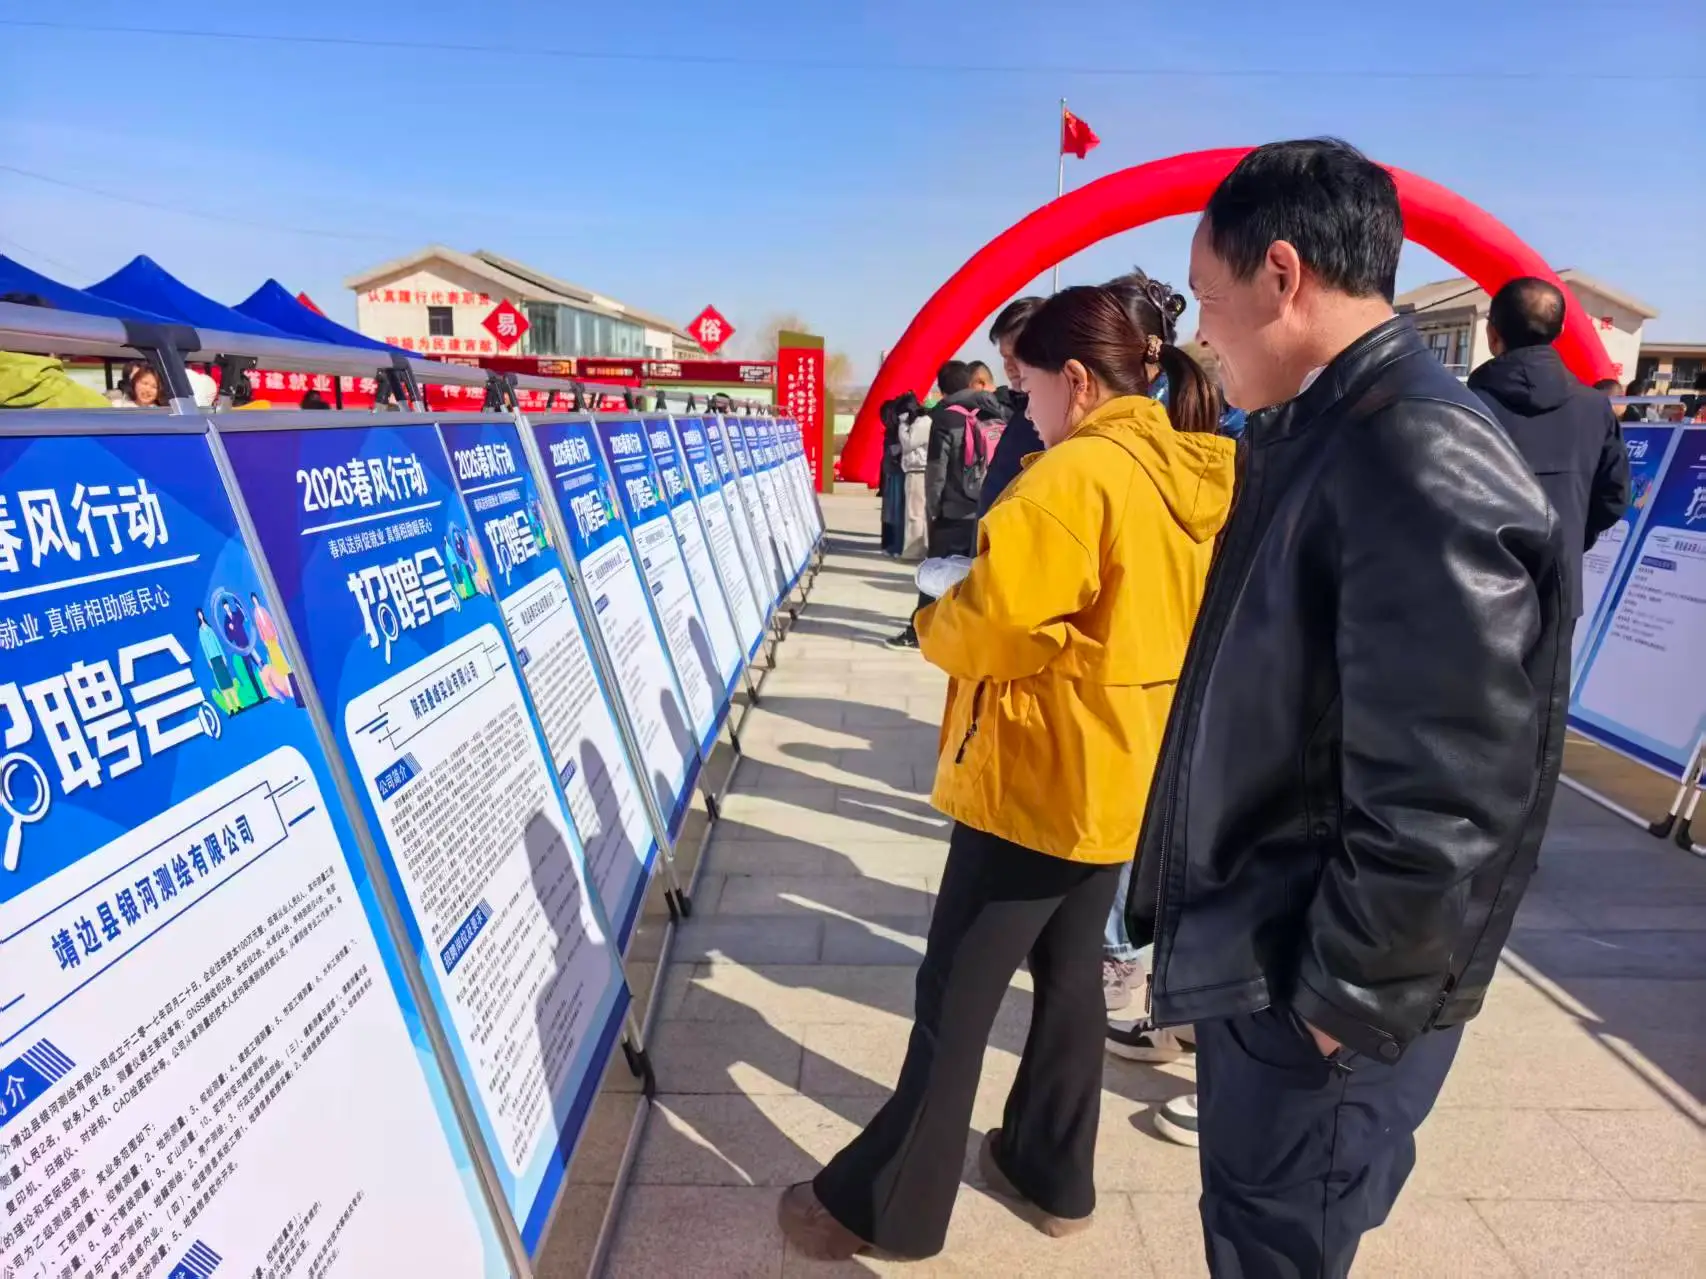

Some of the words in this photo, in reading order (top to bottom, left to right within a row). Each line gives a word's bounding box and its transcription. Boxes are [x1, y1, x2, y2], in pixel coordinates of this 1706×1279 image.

[497, 312, 517, 337] 易
[700, 318, 721, 342] 俗
[296, 453, 428, 513] 2026春风行动
[454, 442, 516, 480] 2026春风行动
[328, 529, 386, 559] 春风送岗促就业
[484, 510, 539, 582] 招聘会
[45, 584, 170, 638] 真情相助暖民心
[347, 546, 457, 660] 招聘会
[379, 764, 409, 797] 公司简介
[51, 814, 256, 971] 靖边县银河测绘有限公司
